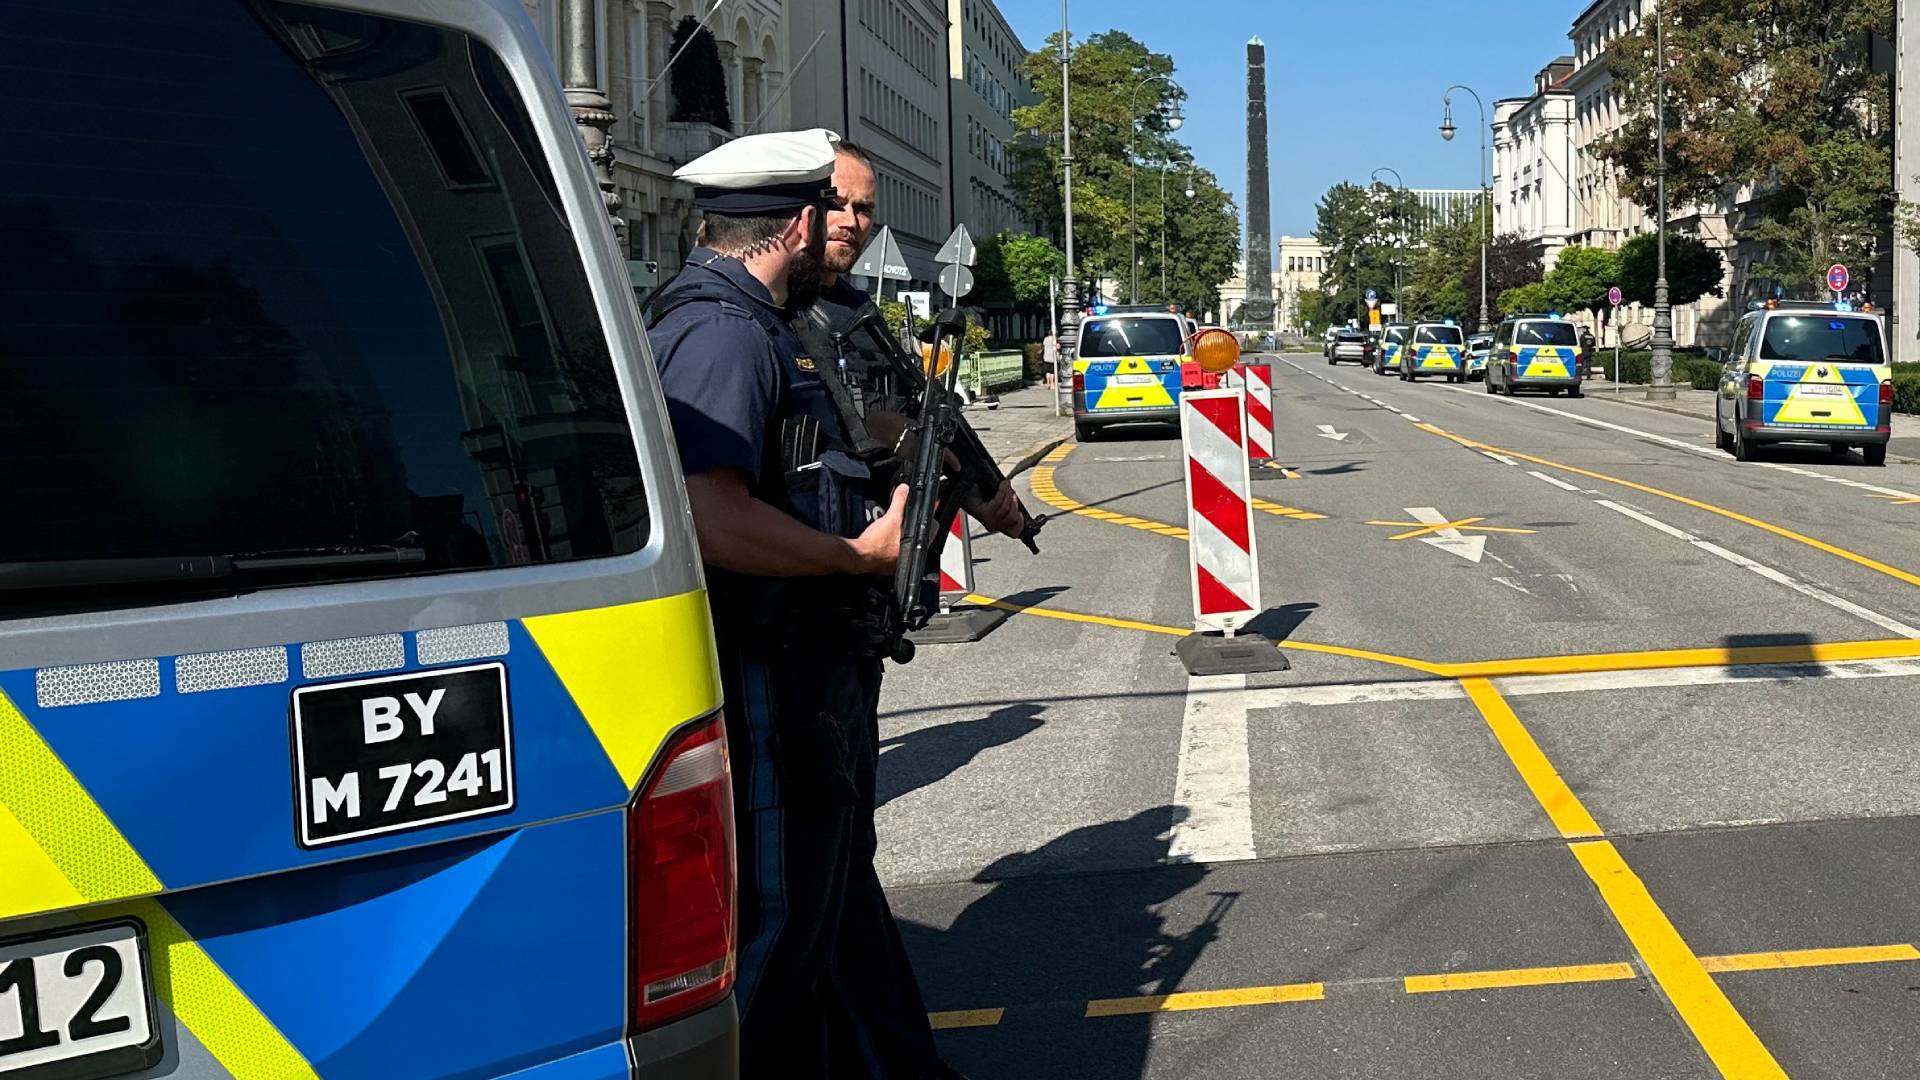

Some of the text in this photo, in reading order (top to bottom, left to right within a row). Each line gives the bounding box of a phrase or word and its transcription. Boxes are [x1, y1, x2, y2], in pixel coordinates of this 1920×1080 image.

[1771, 369, 1801, 378] POLIZEI
[361, 688, 446, 744] BY
[311, 749, 503, 824] M 7241
